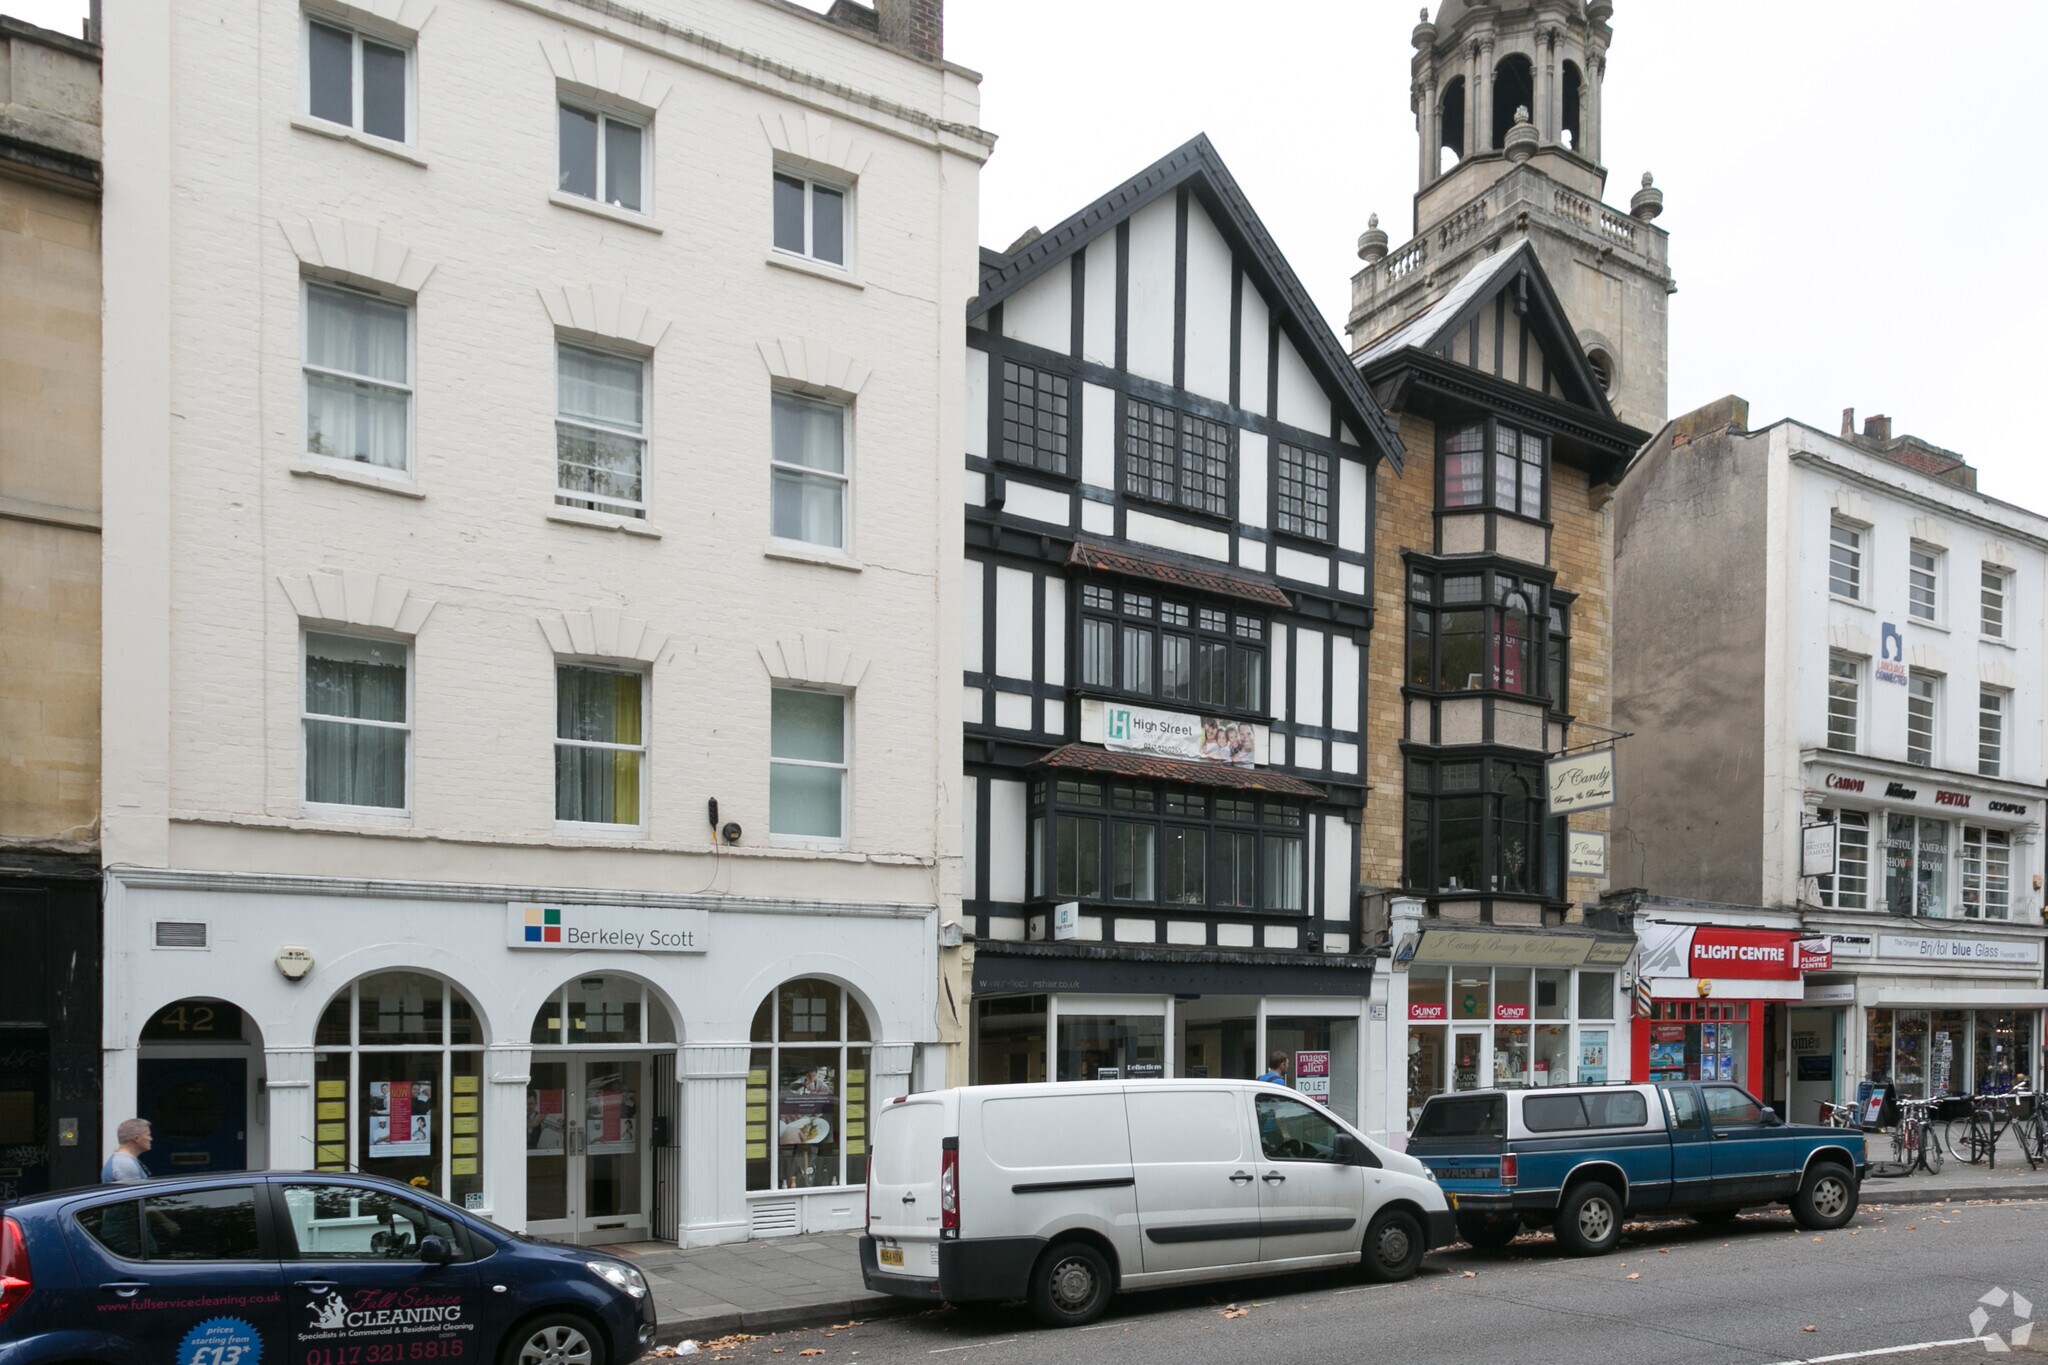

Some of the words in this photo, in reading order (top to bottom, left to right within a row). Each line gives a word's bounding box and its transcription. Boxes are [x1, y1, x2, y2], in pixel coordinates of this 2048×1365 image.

[1133, 718, 1157, 733] High
[1160, 722, 1193, 736] Street
[1567, 766, 1611, 788] Candy
[1825, 773, 1865, 792] Canon
[1884, 782, 1917, 800] Nikon
[1935, 790, 1971, 807] PENTAX
[1989, 801, 2026, 815] OLYMPUS
[1580, 842, 1603, 859] Candy
[1804, 848, 1832, 856] CAMERAS
[1806, 842, 1831, 850] BRISTOL
[1921, 860, 1942, 872] ROOM
[568, 928, 644, 948] Berkeley
[650, 930, 694, 947] Scott
[1447, 934, 1480, 953] Candy
[1482, 938, 1520, 956] Beauty
[1537, 939, 1579, 959] Boutique
[1694, 945, 1738, 960] FLIGHT
[1739, 946, 1785, 961] CENTRE
[1952, 942, 1971, 956] blue
[1975, 943, 1999, 957] Glass
[1412, 1005, 1441, 1016] GUINOT
[1498, 1005, 1525, 1016] GUINOT
[161, 1007, 214, 1031] 42
[1300, 1054, 1327, 1064] maggs
[1303, 1063, 1324, 1072] allen
[1299, 1082, 1311, 1091] TO
[1313, 1081, 1326, 1091] LET
[97, 1291, 282, 1312] www.fullservicecleaning.co.uk
[350, 1289, 399, 1311] Full
[398, 1287, 462, 1307] Service
[347, 1306, 461, 1327] CLEANING
[206, 1326, 234, 1335] prices
[298, 1331, 337, 1341] Specialists
[348, 1327, 393, 1337] Commercial
[402, 1324, 441, 1334] Residential
[443, 1322, 474, 1332] Cleaning
[191, 1337, 226, 1346] starting
[228, 1335, 250, 1345] from
[306, 1347, 362, 1365] 0117
[366, 1344, 404, 1363] 321
[409, 1340, 464, 1360] 5815
